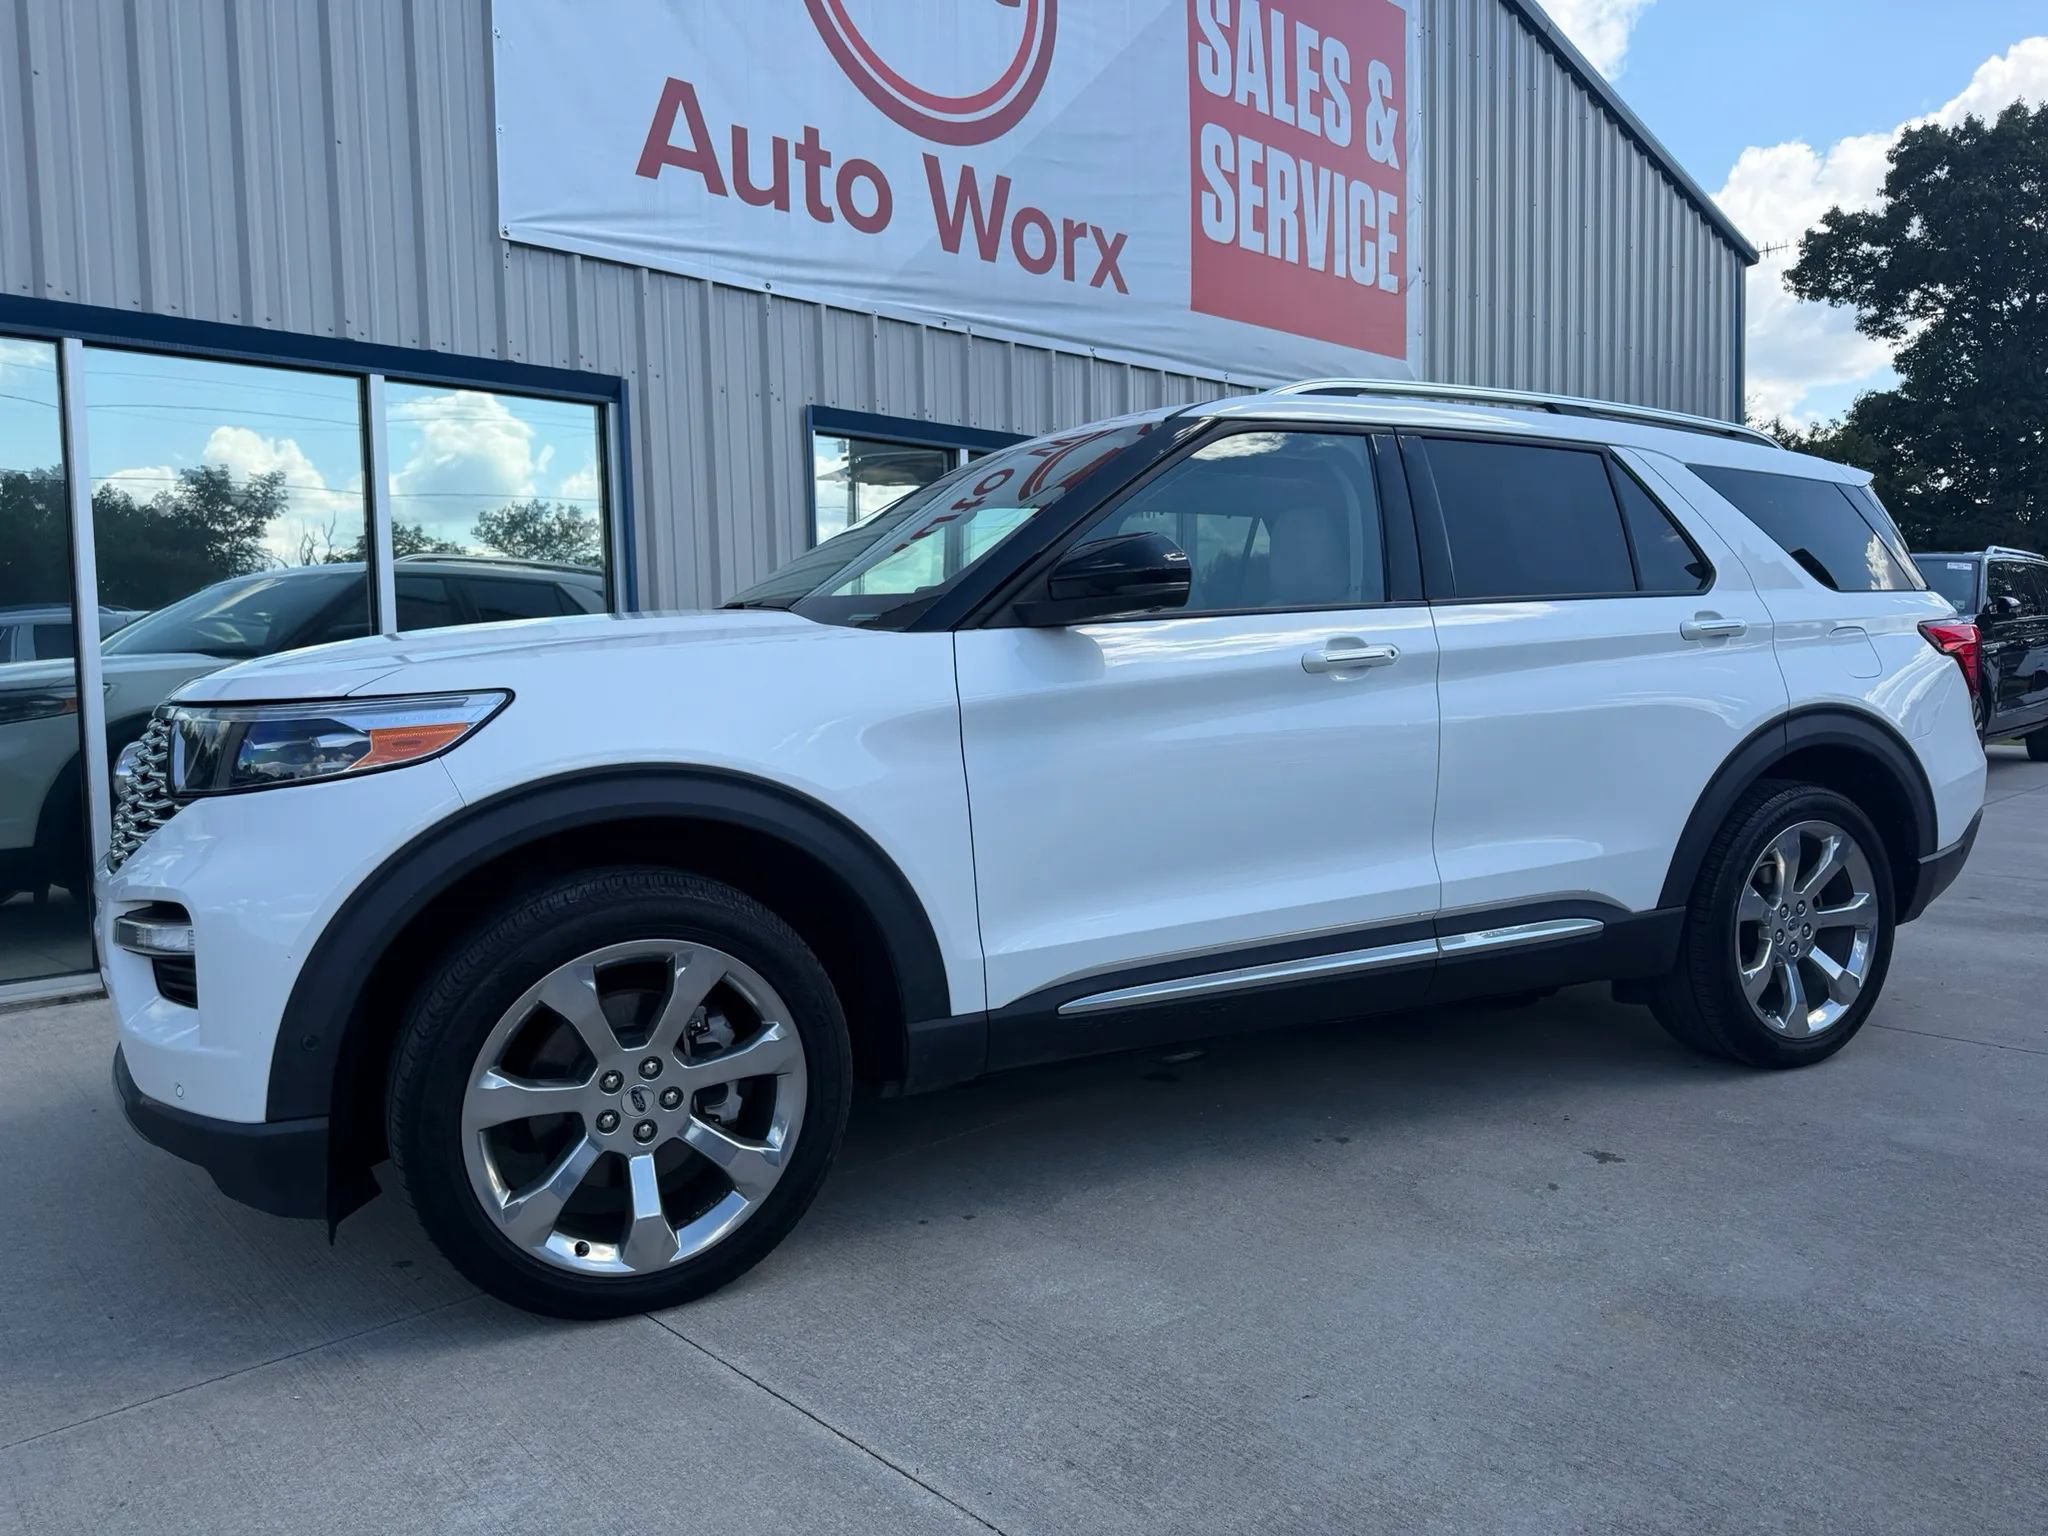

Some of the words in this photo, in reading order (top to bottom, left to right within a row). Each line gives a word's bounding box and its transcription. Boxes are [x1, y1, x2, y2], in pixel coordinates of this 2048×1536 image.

[1196, 0, 1352, 148] SALES
[1365, 59, 1400, 170] &
[636, 76, 892, 233] Auto
[922, 152, 1129, 294] Worx
[1200, 122, 1399, 294] SERVICE
